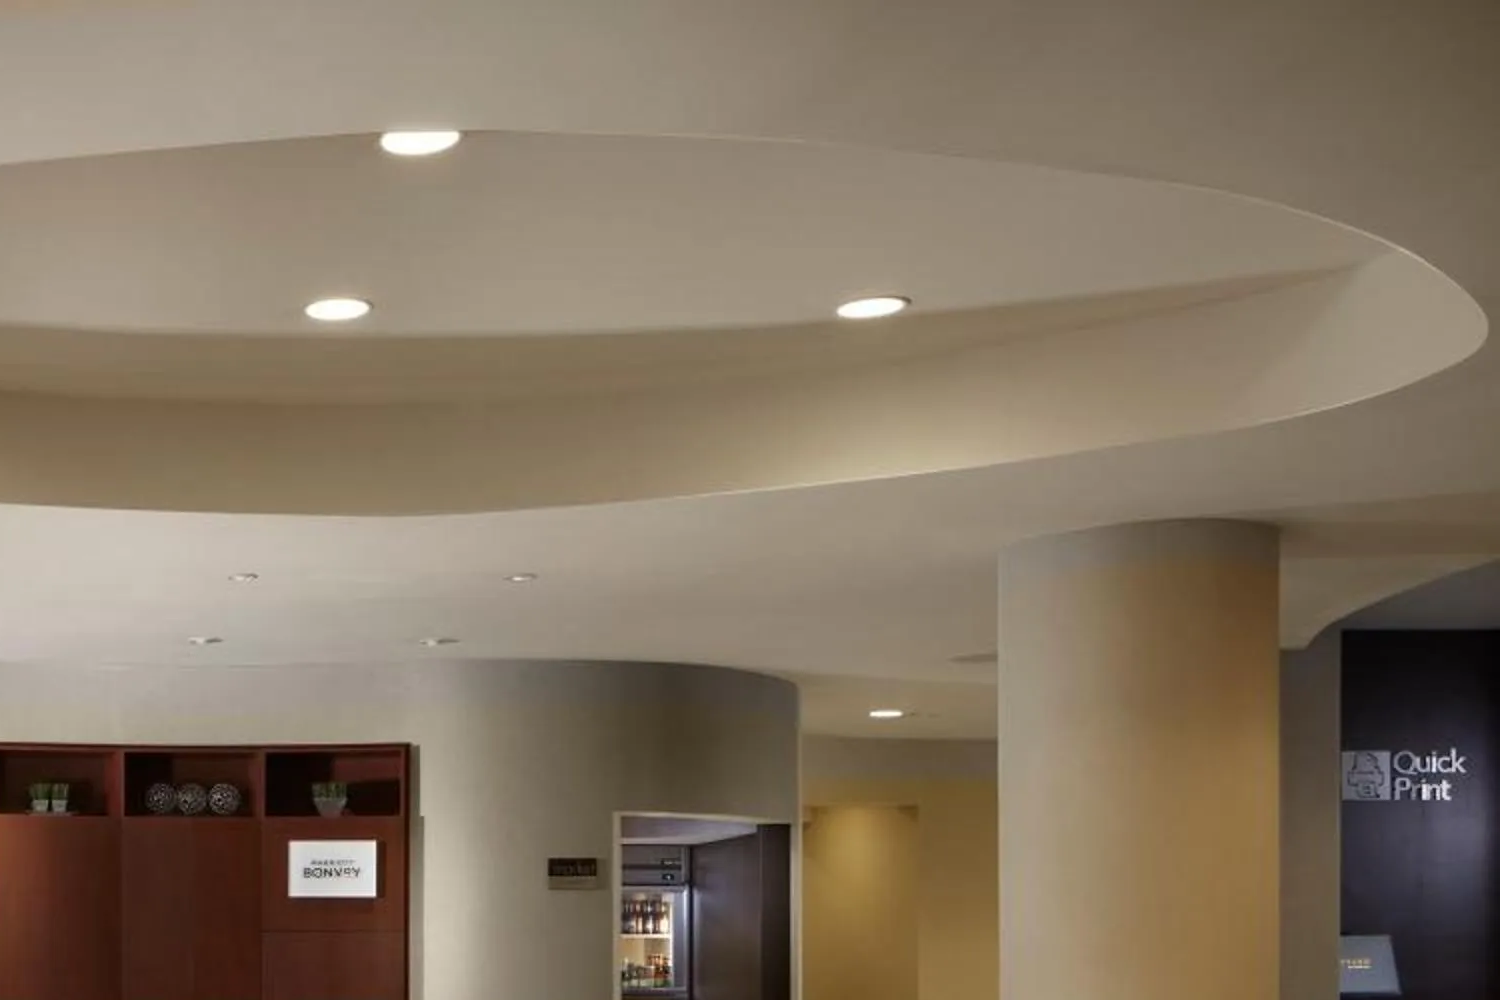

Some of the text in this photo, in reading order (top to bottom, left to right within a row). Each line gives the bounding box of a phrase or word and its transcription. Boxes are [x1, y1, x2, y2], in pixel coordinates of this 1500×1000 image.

[1394, 748, 1467, 775] Quick
[1394, 777, 1452, 801] Print
[303, 867, 361, 879] BONVOY
